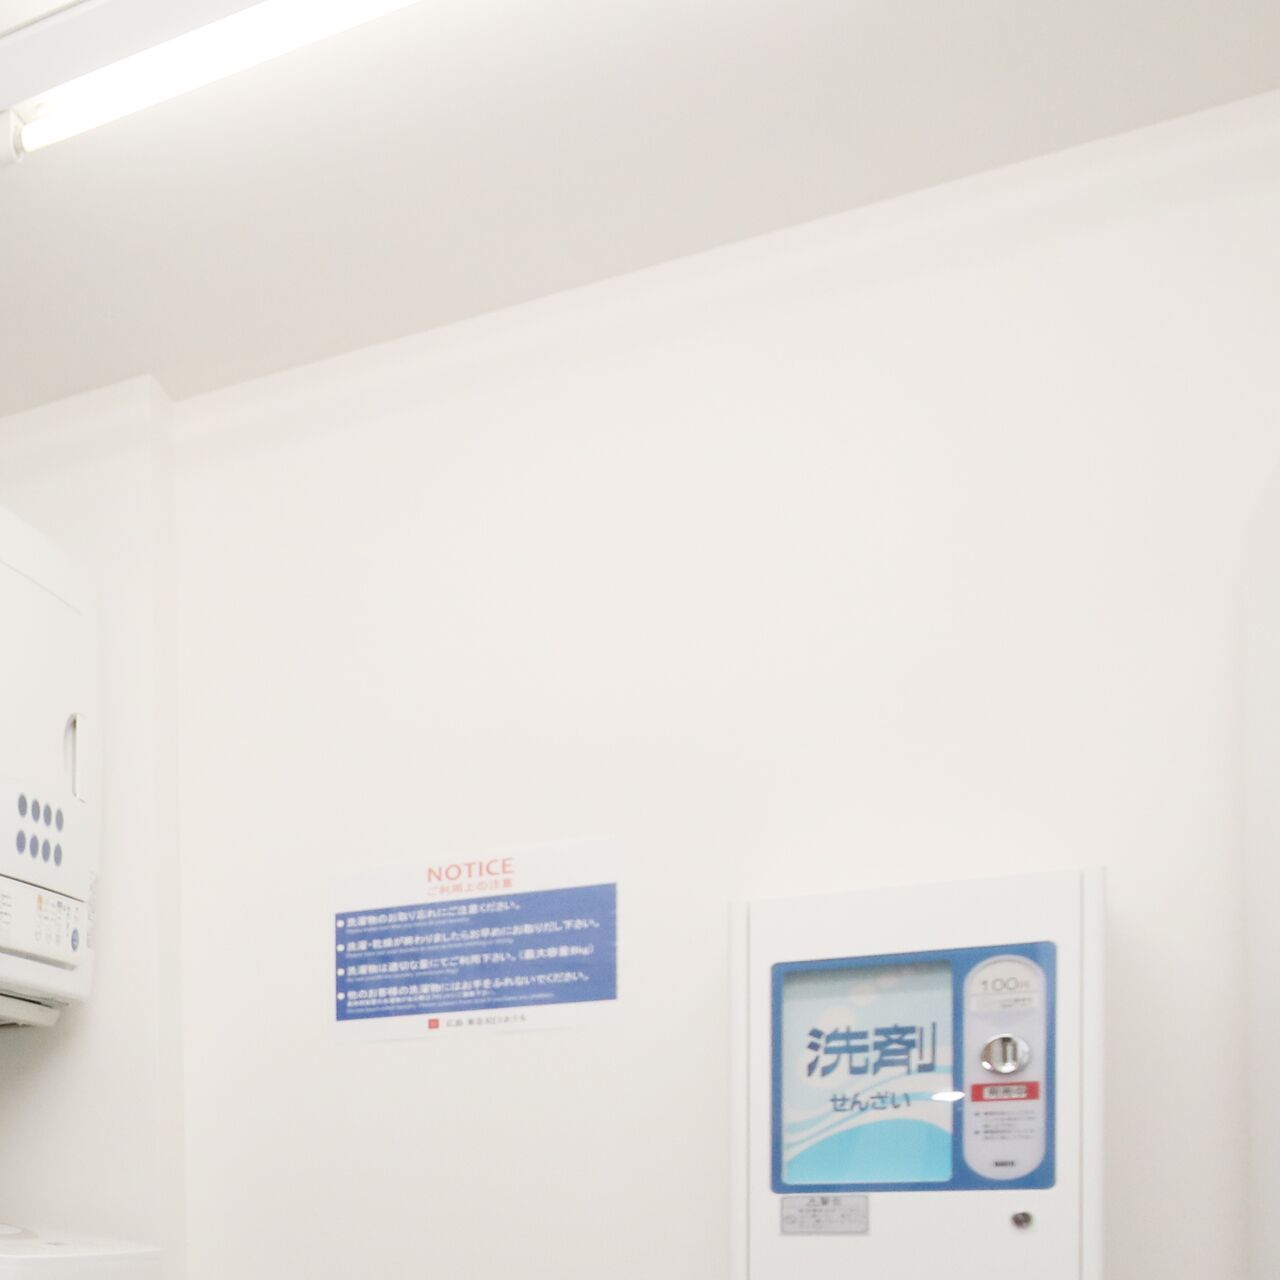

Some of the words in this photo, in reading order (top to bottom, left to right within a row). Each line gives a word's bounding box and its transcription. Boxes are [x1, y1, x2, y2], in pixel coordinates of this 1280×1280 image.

[426, 857, 514, 883] NOTICE
[806, 1020, 938, 1078] 洗剤
[829, 1091, 912, 1113] せんざい
